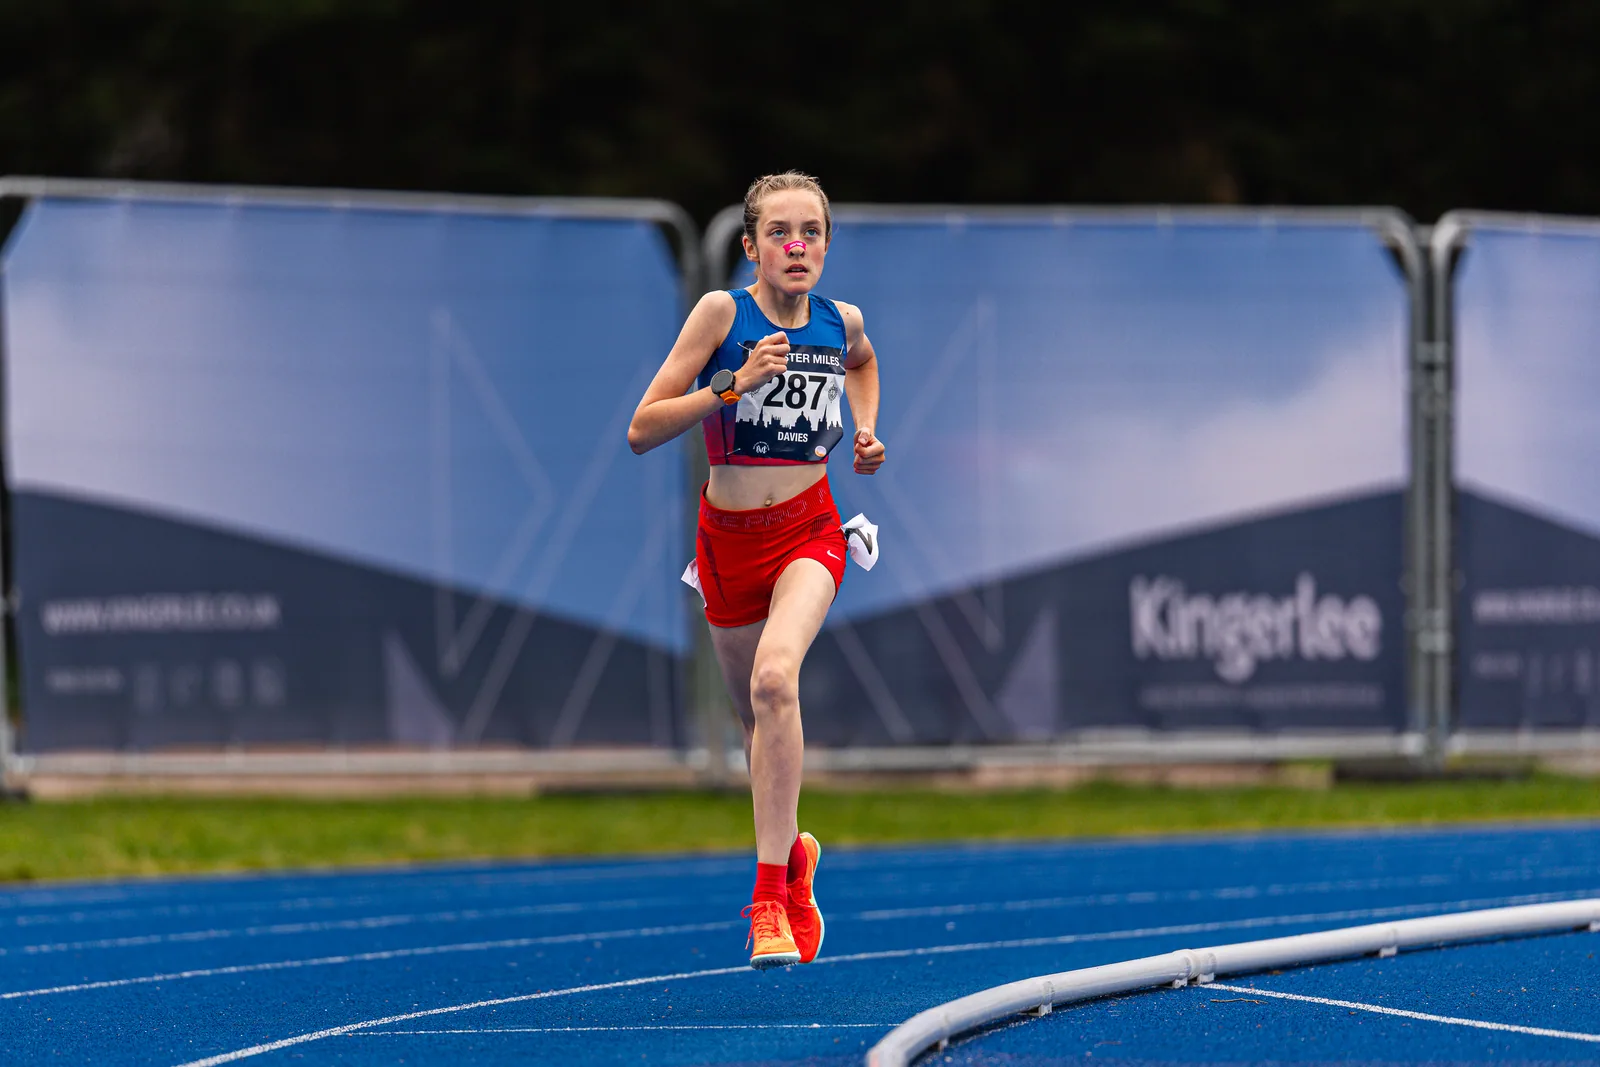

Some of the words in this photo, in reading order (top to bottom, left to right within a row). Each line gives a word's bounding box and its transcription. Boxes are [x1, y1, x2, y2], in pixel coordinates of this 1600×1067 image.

[813, 354, 840, 367] MILES
[762, 373, 827, 410] 287
[777, 431, 809, 443] DAVIES
[1130, 573, 1381, 682] Kingerlee
